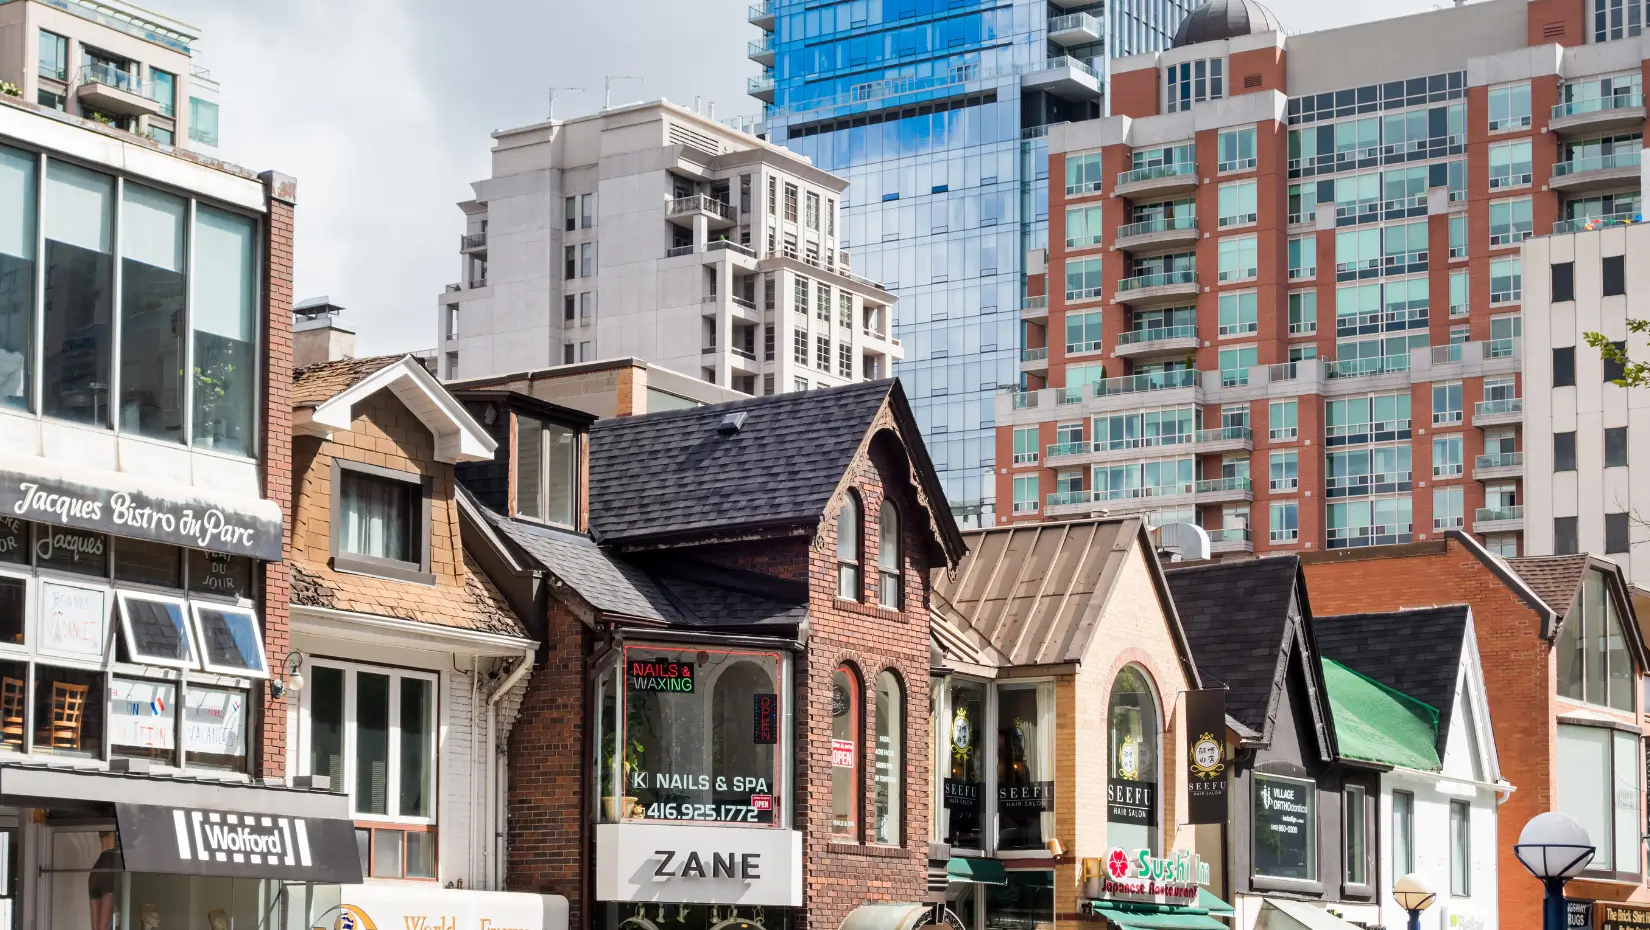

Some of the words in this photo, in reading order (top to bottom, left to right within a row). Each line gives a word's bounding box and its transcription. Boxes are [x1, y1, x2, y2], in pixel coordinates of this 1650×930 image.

[14, 482, 103, 523] Jacques
[111, 492, 175, 532] Bistro
[200, 509, 254, 546] Parc
[212, 563, 226, 575] DU
[203, 575, 235, 590] JOUR
[633, 663, 678, 678] NAILS
[682, 666, 691, 678] &
[633, 677, 692, 691] WAXING
[760, 697, 771, 741] OPEN
[832, 750, 852, 766] OPEN
[634, 772, 648, 788] K
[656, 773, 710, 791] NAILS
[715, 776, 728, 791] &
[733, 777, 768, 793] SPA
[1189, 781, 1227, 791] SEEFU
[945, 783, 977, 798] SEEFU
[1000, 787, 1053, 799] SEEFU
[1108, 784, 1152, 806] SEEFU
[1273, 788, 1294, 800] VILLAGE
[754, 800, 769, 808] OPEN
[647, 802, 758, 822] 416.925.1772
[1113, 807, 1127, 816] HAIR
[1128, 810, 1147, 818] SALON
[204, 824, 281, 853] Wolford
[654, 850, 761, 880] ZANE
[1138, 849, 1190, 883] Sushi
[1101, 880, 1146, 897] Japanese
[1148, 882, 1197, 899] Restaurant
[1567, 913, 1585, 925] RUGS
[1606, 908, 1617, 921] The
[1618, 909, 1631, 922] Brick
[1632, 910, 1645, 924] Shirt
